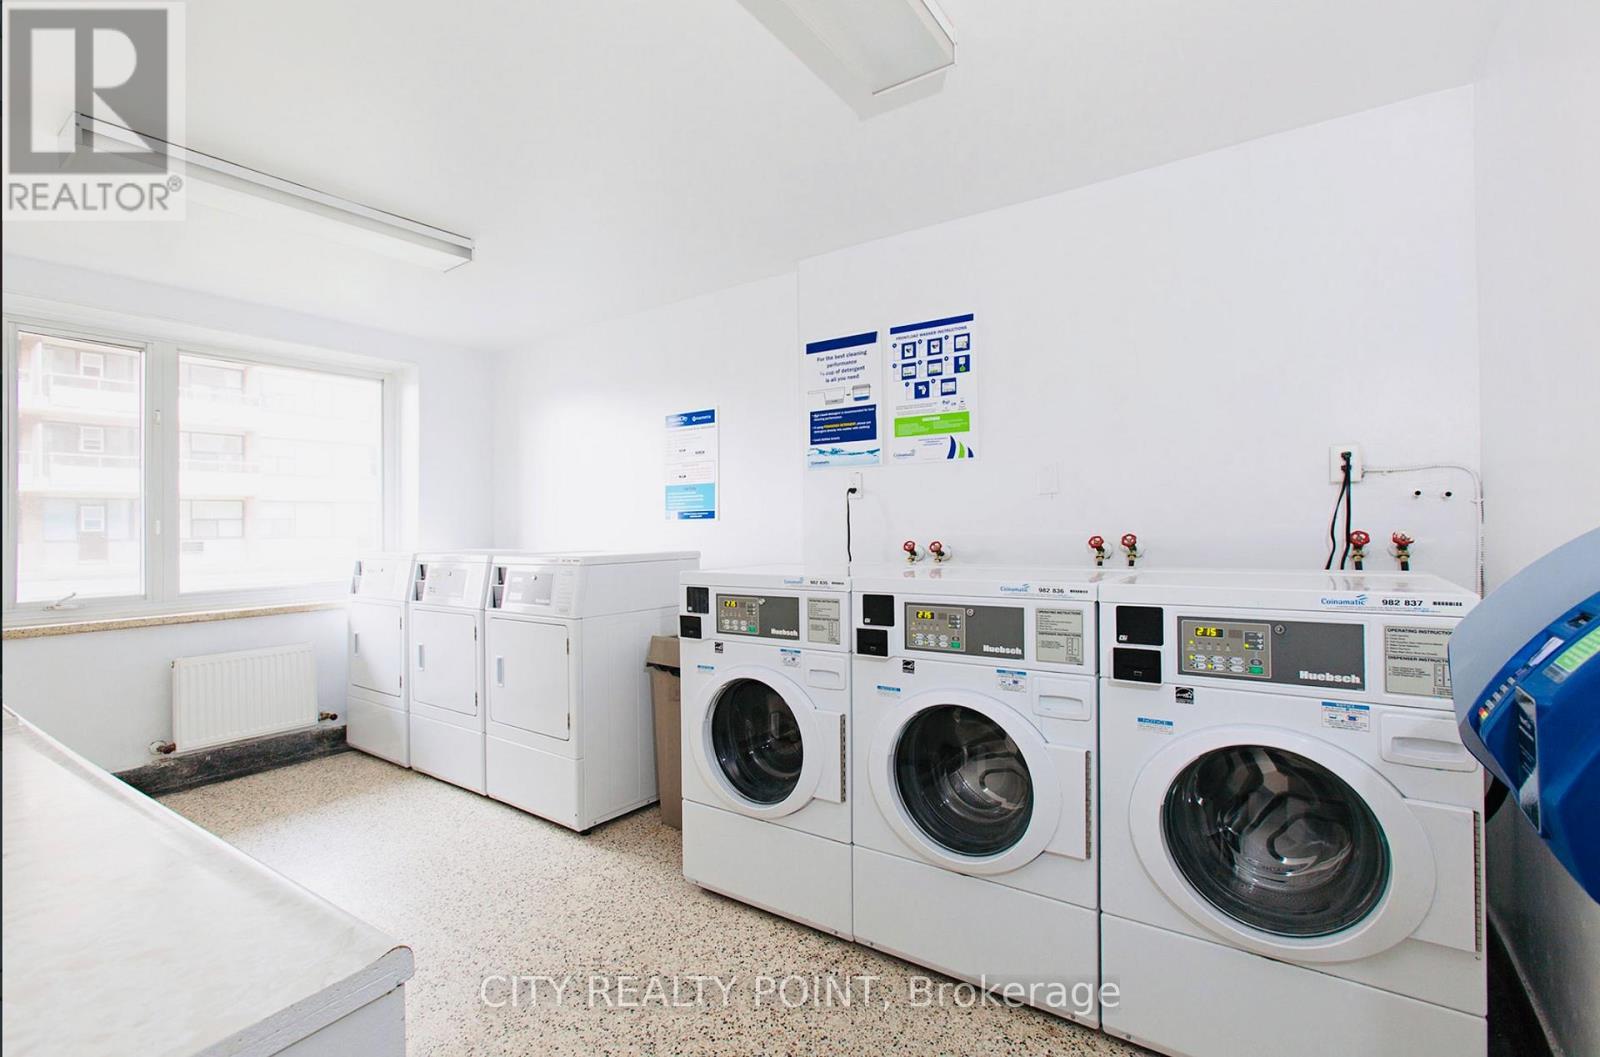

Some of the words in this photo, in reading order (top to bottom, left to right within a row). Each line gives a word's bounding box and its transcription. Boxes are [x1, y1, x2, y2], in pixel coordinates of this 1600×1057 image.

[846, 350, 867, 358] cleaning
[827, 360, 857, 369] performance
[841, 365, 865, 373] detergent
[1321, 596, 1365, 606] Coinamatic
[1404, 599, 1423, 607] 837
[983, 644, 1022, 655] Huebsch
[1299, 670, 1361, 684] Huebsch
